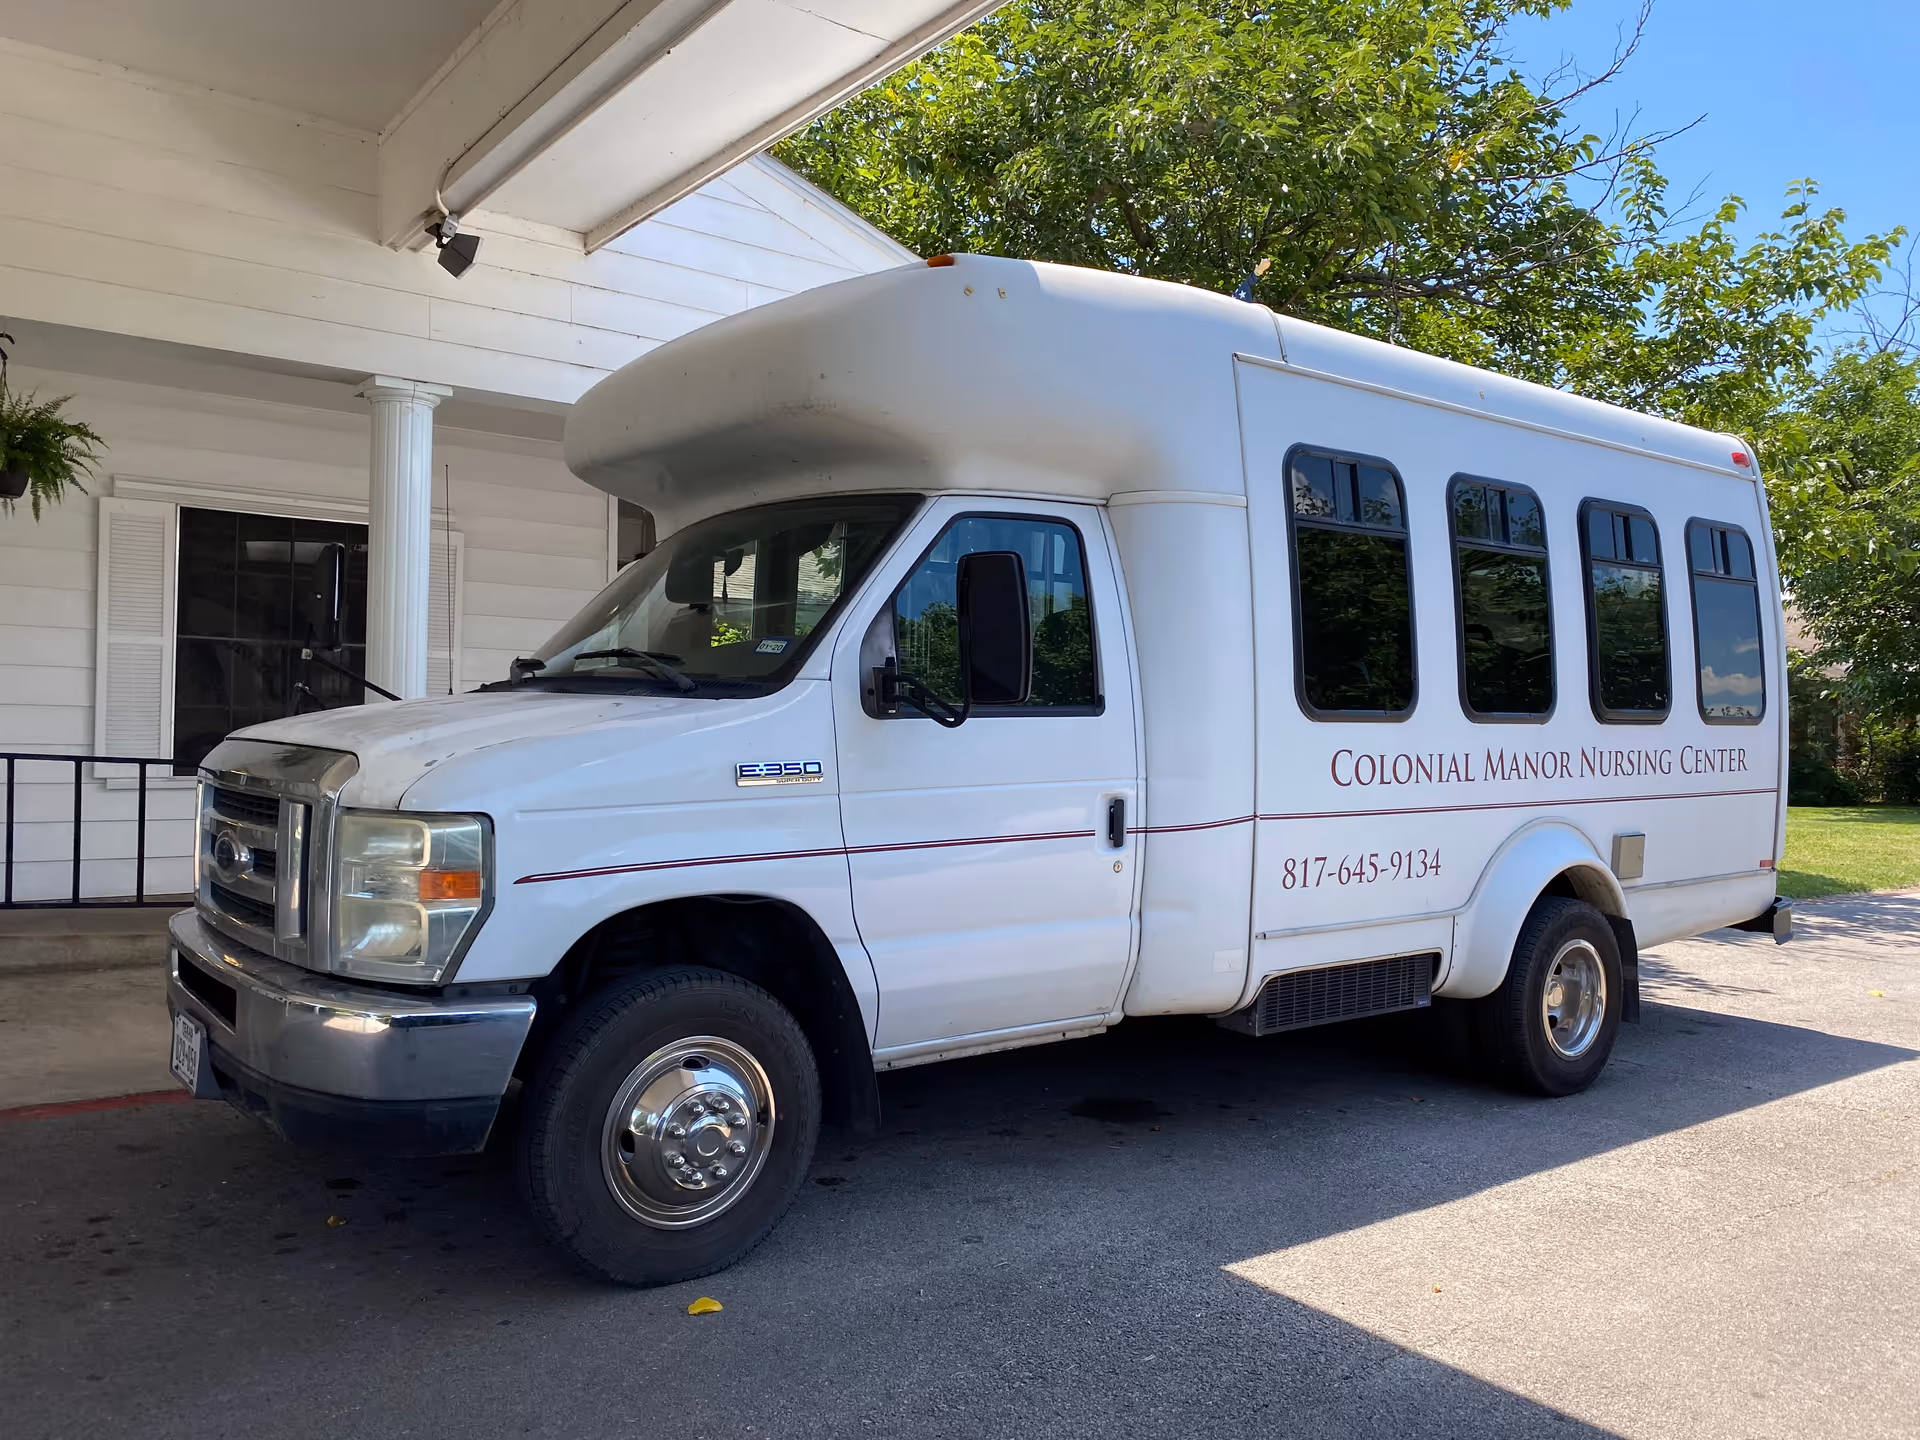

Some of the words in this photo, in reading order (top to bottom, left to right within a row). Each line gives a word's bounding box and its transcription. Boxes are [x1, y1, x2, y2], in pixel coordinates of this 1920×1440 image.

[738, 760, 823, 777] E-350
[1331, 748, 1476, 787] COLONIAL
[1483, 747, 1573, 781] MANOR
[1580, 746, 1673, 778] NURSING
[1680, 744, 1749, 775] CENTER
[1282, 847, 1442, 890] 817-645-9134
